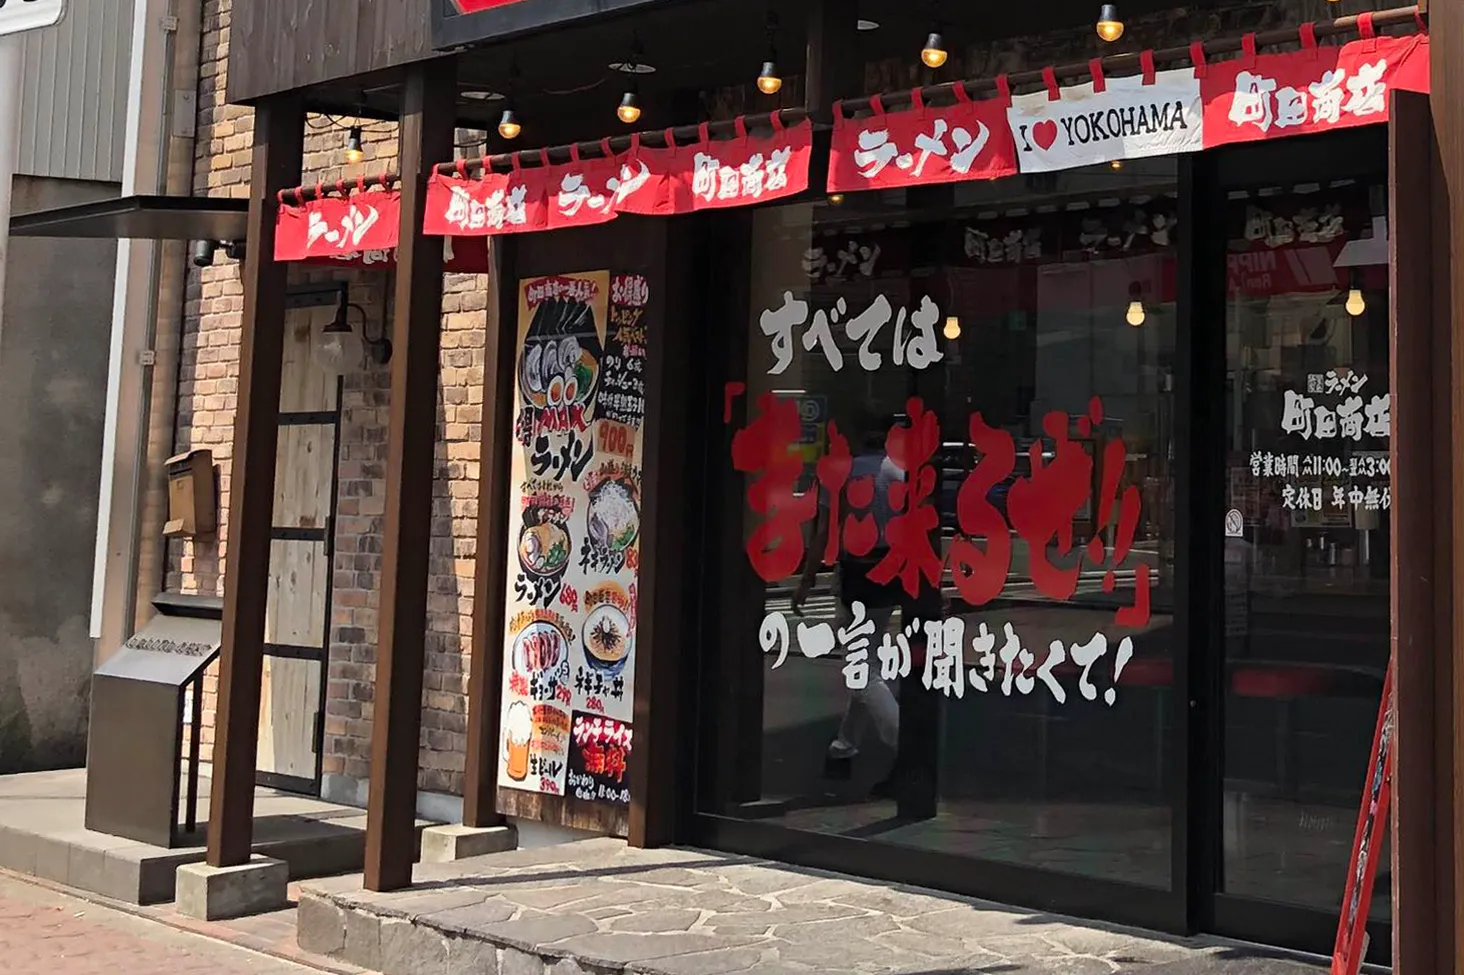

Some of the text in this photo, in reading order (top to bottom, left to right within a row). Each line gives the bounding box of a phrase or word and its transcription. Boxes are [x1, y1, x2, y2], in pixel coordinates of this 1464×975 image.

[1229, 58, 1387, 133] 町田商店
[1060, 100, 1187, 146] YOKOHAMA
[854, 118, 991, 178] ラーメン
[558, 159, 650, 216] ラーメン
[693, 146, 791, 201] 町田商店
[306, 203, 379, 249] ラーメン
[444, 184, 527, 230] 町田商店
[759, 290, 944, 375] すべては
[1325, 370, 1369, 396] ラーメン
[538, 404, 590, 432] MAX
[1281, 389, 1390, 441] 町田商店
[531, 430, 593, 482] ラーメン
[1250, 451, 1299, 477] 営業時間
[1282, 484, 1322, 511] 定休日
[514, 573, 560, 610] ラーメン
